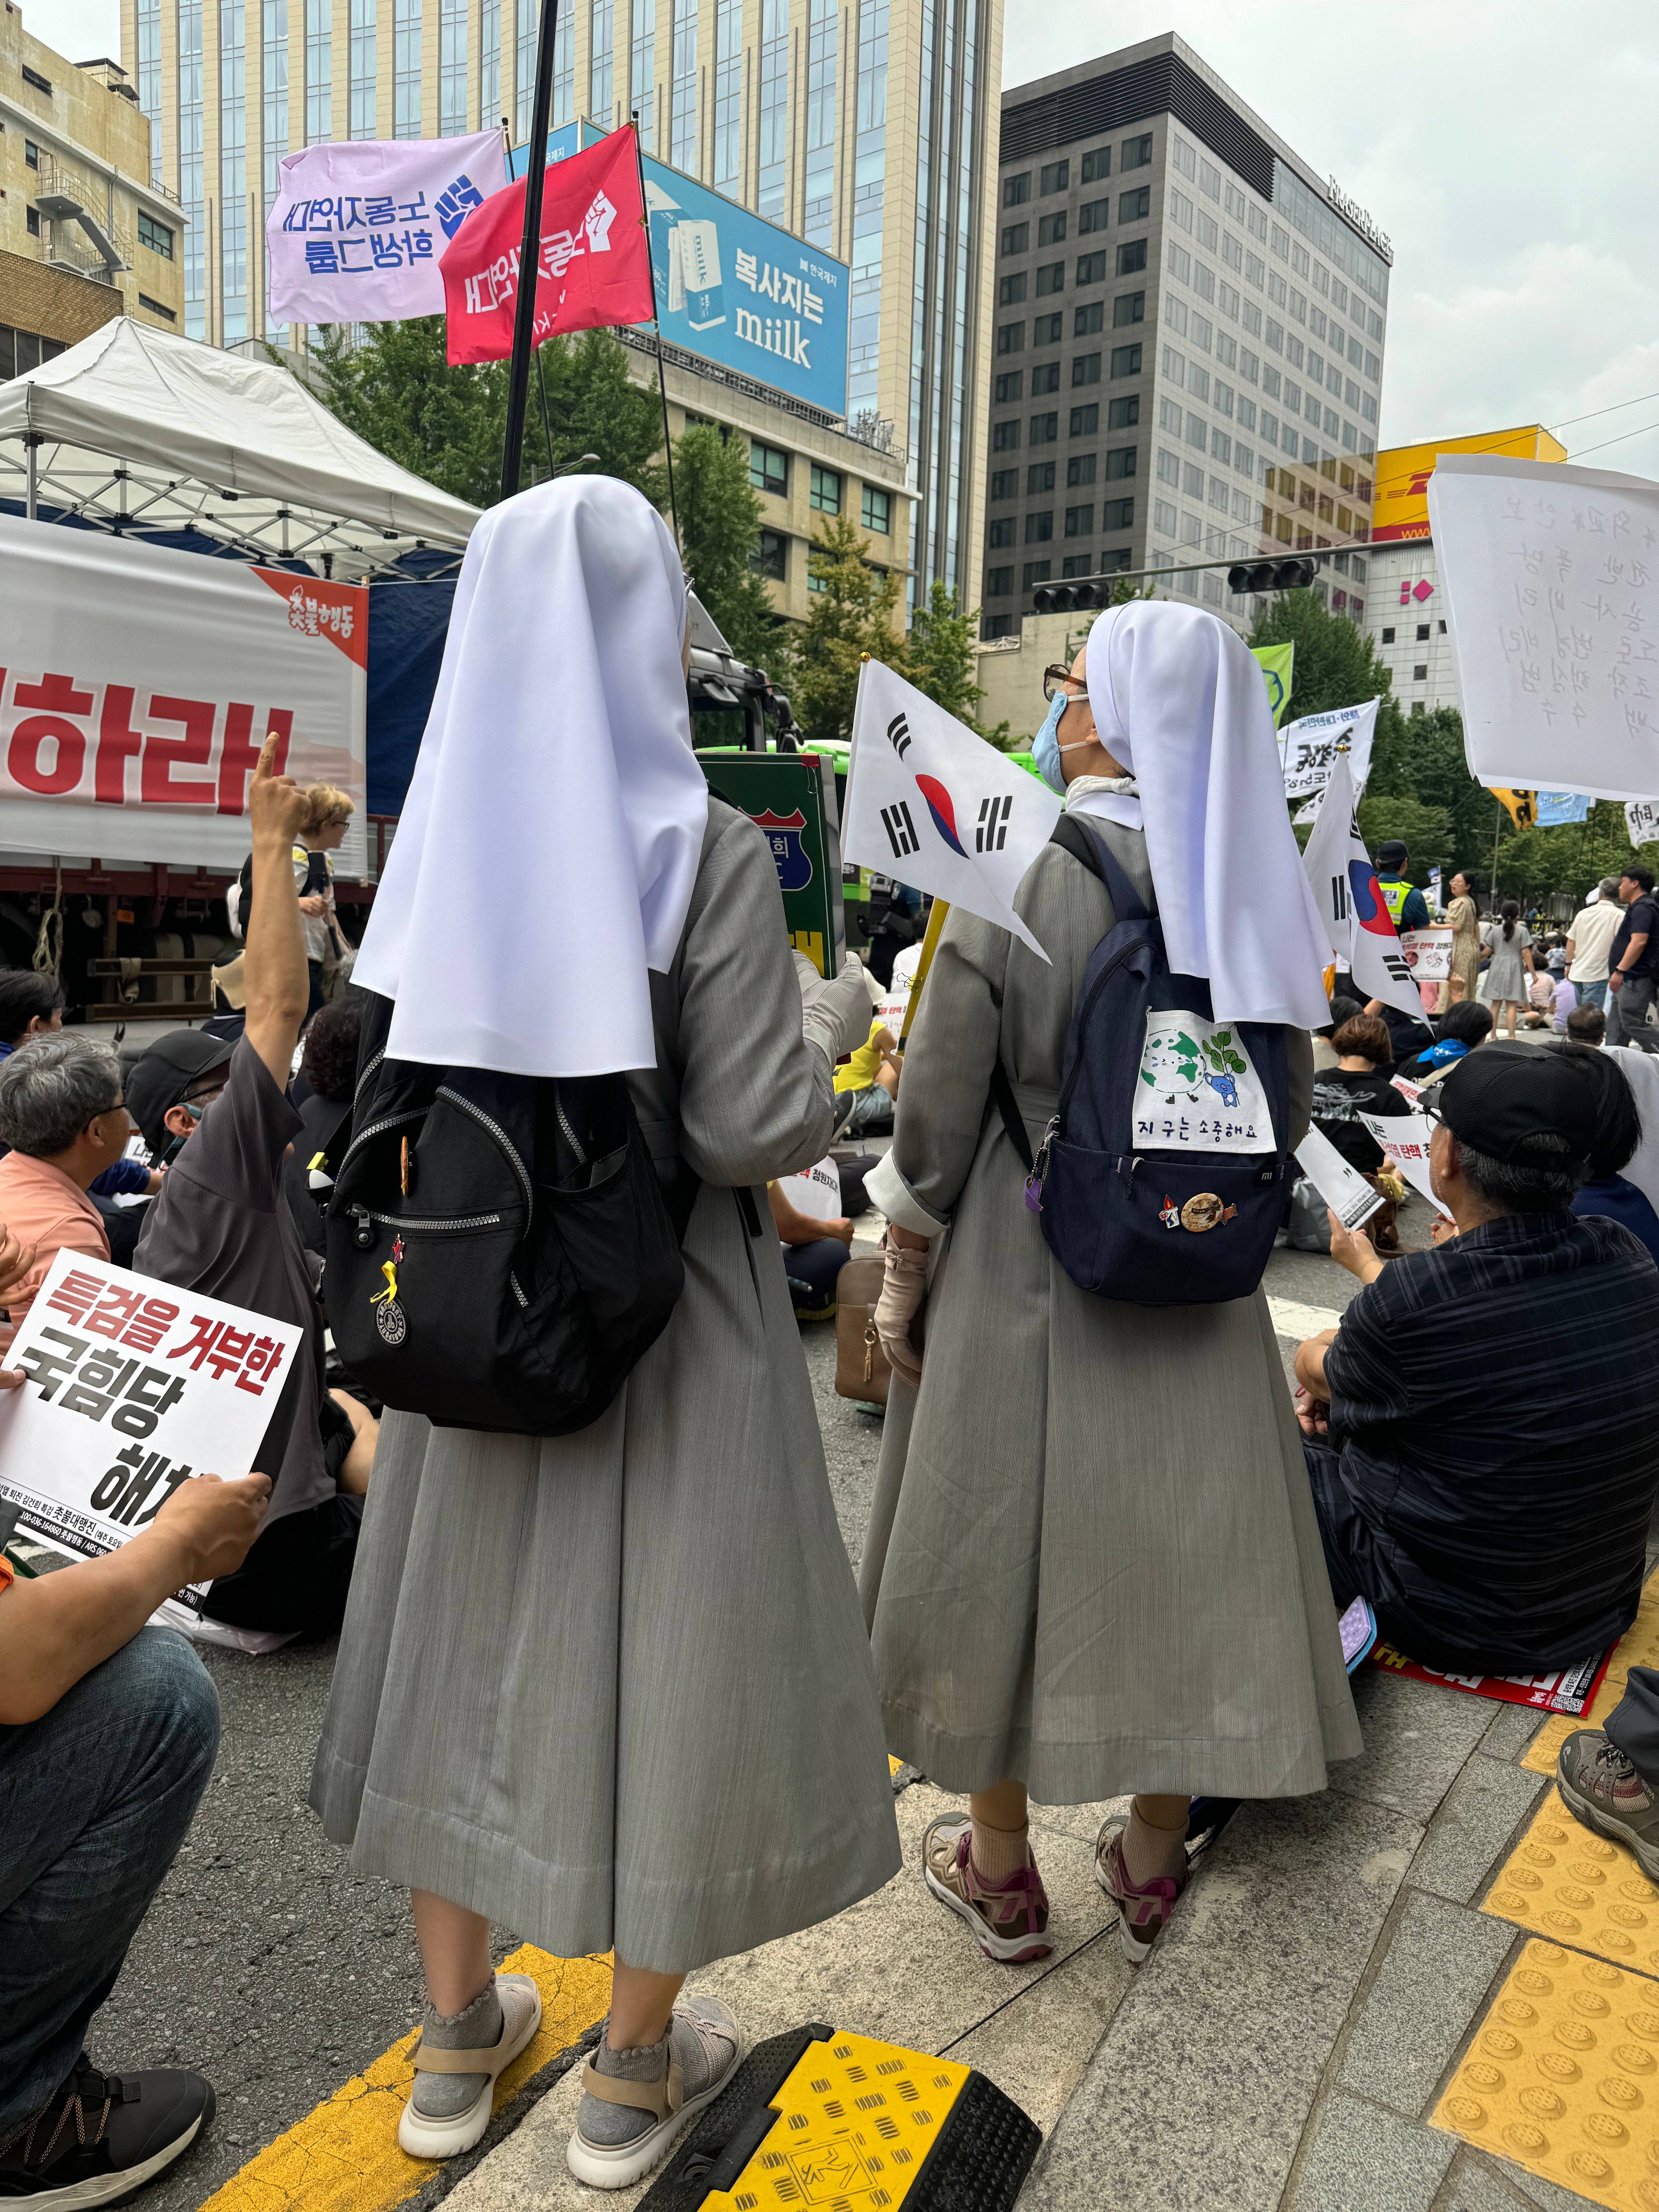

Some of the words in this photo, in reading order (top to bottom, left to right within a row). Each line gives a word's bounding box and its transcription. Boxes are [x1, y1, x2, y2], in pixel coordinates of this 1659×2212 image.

[735, 247, 824, 325] 복사지는
[810, 264, 837, 287] 한국제지
[735, 308, 811, 369] miilk
[289, 586, 354, 639] 촛불행동
[1138, 1116, 1189, 1141] 지구는
[1199, 1120, 1257, 1142] 소중해요
[1366, 1119, 1388, 1139] 나는
[1399, 1144, 1423, 1159] 탄핵
[46, 1269, 180, 1353] 특검을
[165, 1314, 287, 1396] 거부한
[15, 1326, 187, 1439] 국힘당
[9, 1489, 23, 1502] 퇴진
[23, 1495, 42, 1511] 김건희
[41, 1503, 55, 1515] 특검
[52, 1506, 97, 1536] 촛불대행진
[20, 1511, 62, 1536] 100-036-164860
[60, 1529, 84, 1547] 촛불행동
[85, 1541, 97, 1554] ARS
[184, 1591, 198, 1606] 가능)
